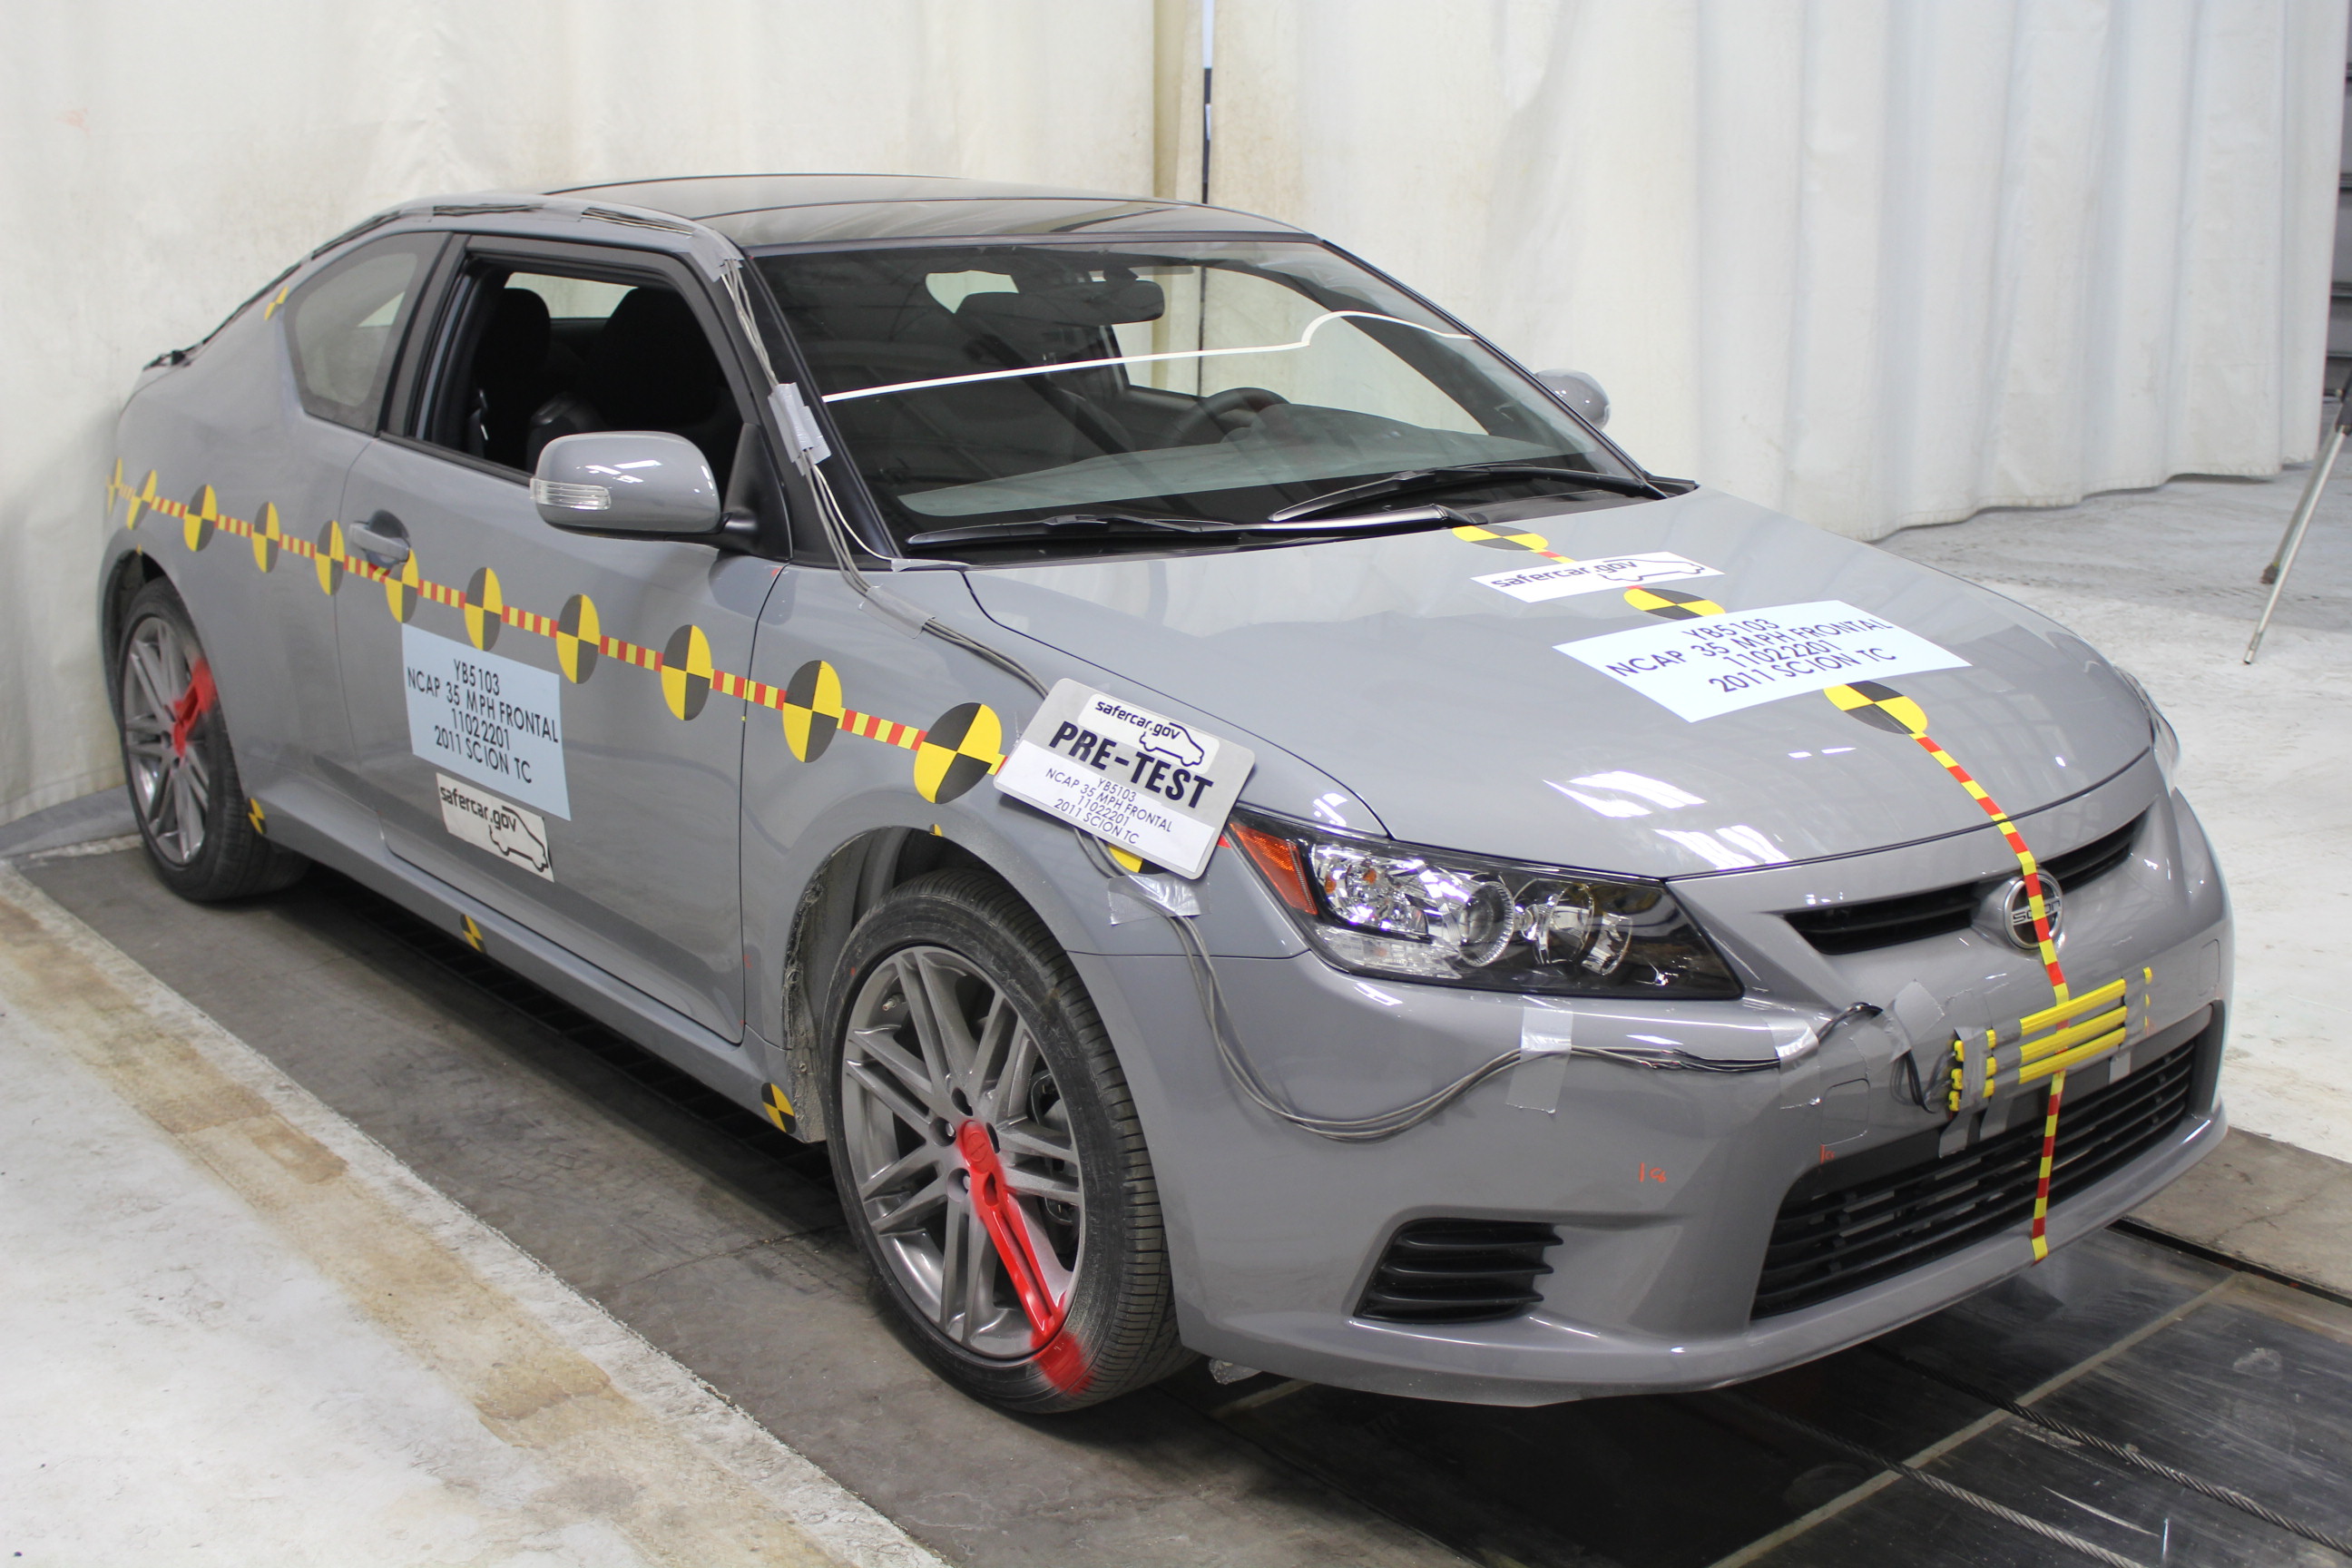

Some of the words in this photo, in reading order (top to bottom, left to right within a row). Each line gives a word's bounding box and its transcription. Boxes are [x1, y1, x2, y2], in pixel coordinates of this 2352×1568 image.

[1491, 560, 1638, 588] safercar.gov
[1605, 650, 1687, 677] NCAP
[1690, 642, 1730, 657] 35
[1730, 631, 1797, 650] MPH
[1788, 619, 1894, 640] FRONTAL
[1681, 618, 1780, 641] YB5103
[1709, 669, 1776, 693] 2011
[1771, 652, 1862, 678] SCION
[1855, 648, 1896, 662] TC
[1723, 640, 1842, 668] 11022201
[454, 659, 500, 696] YB5103
[407, 667, 440, 697] NCAP
[446, 682, 460, 705] 35
[466, 689, 495, 720] MPH
[500, 701, 559, 743] FRONTAL
[1095, 701, 1180, 740] safercar.gov
[452, 709, 510, 750] 11022201
[435, 725, 461, 754] 2011
[466, 738, 509, 774] SCION
[514, 757, 532, 783] TC
[1049, 720, 1214, 808] PRE-TEST
[440, 786, 517, 832] safercar.gov
[1045, 768, 1080, 788] NCAP
[1080, 784, 1096, 797] 35
[1096, 792, 1123, 810] MPH
[1125, 803, 1173, 832] FRONTAL
[1078, 796, 1130, 827] 11022201
[1097, 778, 1137, 802] YB5103
[1054, 799, 1082, 818] 2011
[1083, 812, 1123, 837] SCION
[1123, 830, 1140, 844] TC
